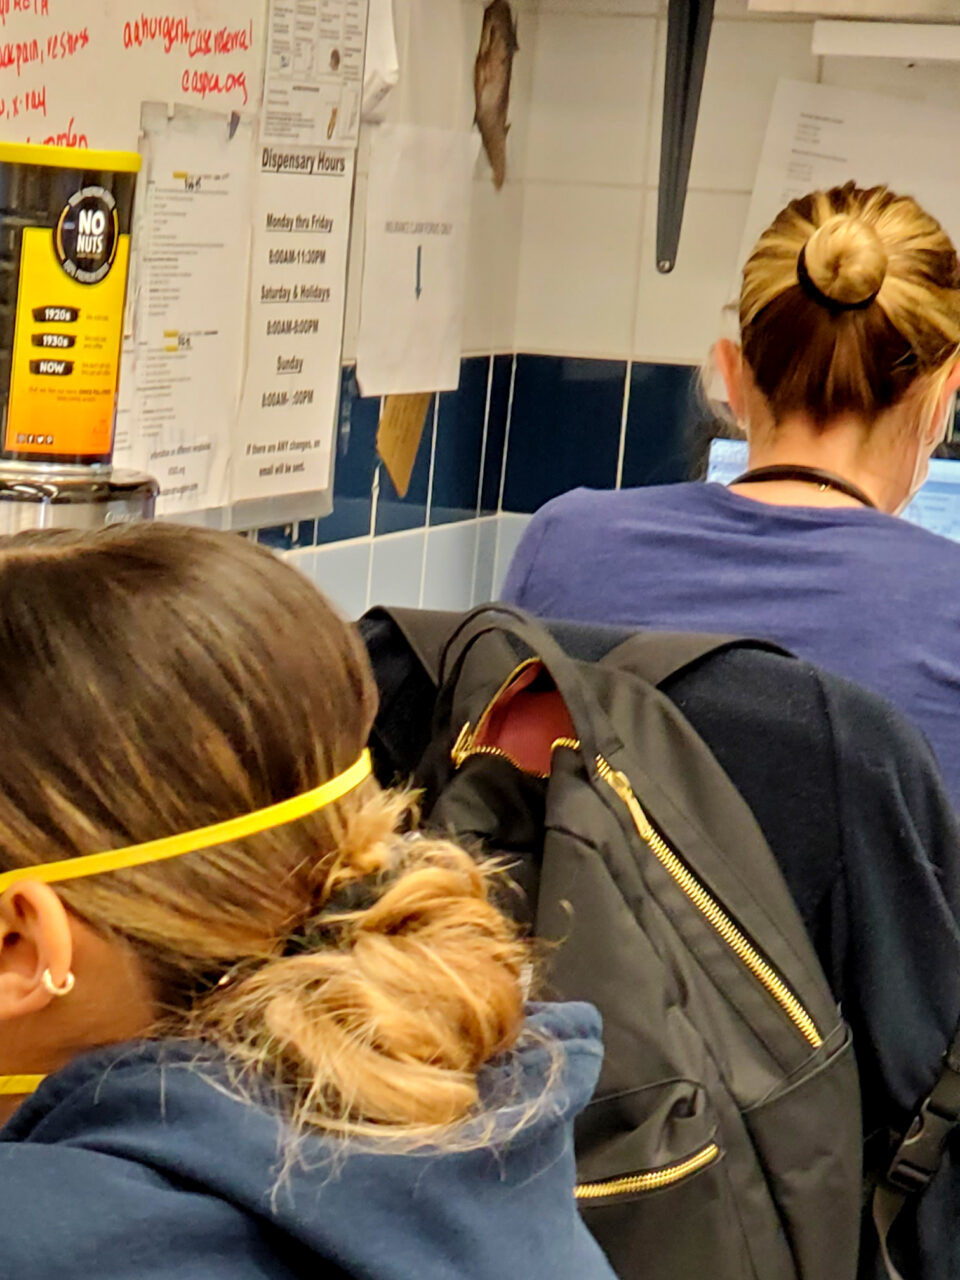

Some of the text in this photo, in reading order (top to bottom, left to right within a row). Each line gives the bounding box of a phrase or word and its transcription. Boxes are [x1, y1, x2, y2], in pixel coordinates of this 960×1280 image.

[261, 147, 346, 175] Dispensary Hours
[78, 208, 105, 235] NO
[266, 213, 334, 233] Monday thru Friday
[76, 234, 104, 254] NUTS
[261, 284, 291, 303] Saturday
[300, 284, 331, 303] Holidays
[44, 307, 71, 322] 1920s
[42, 335, 70, 348] 1930s
[39, 360, 66, 375] NOW
[276, 354, 304, 374] Sunday
